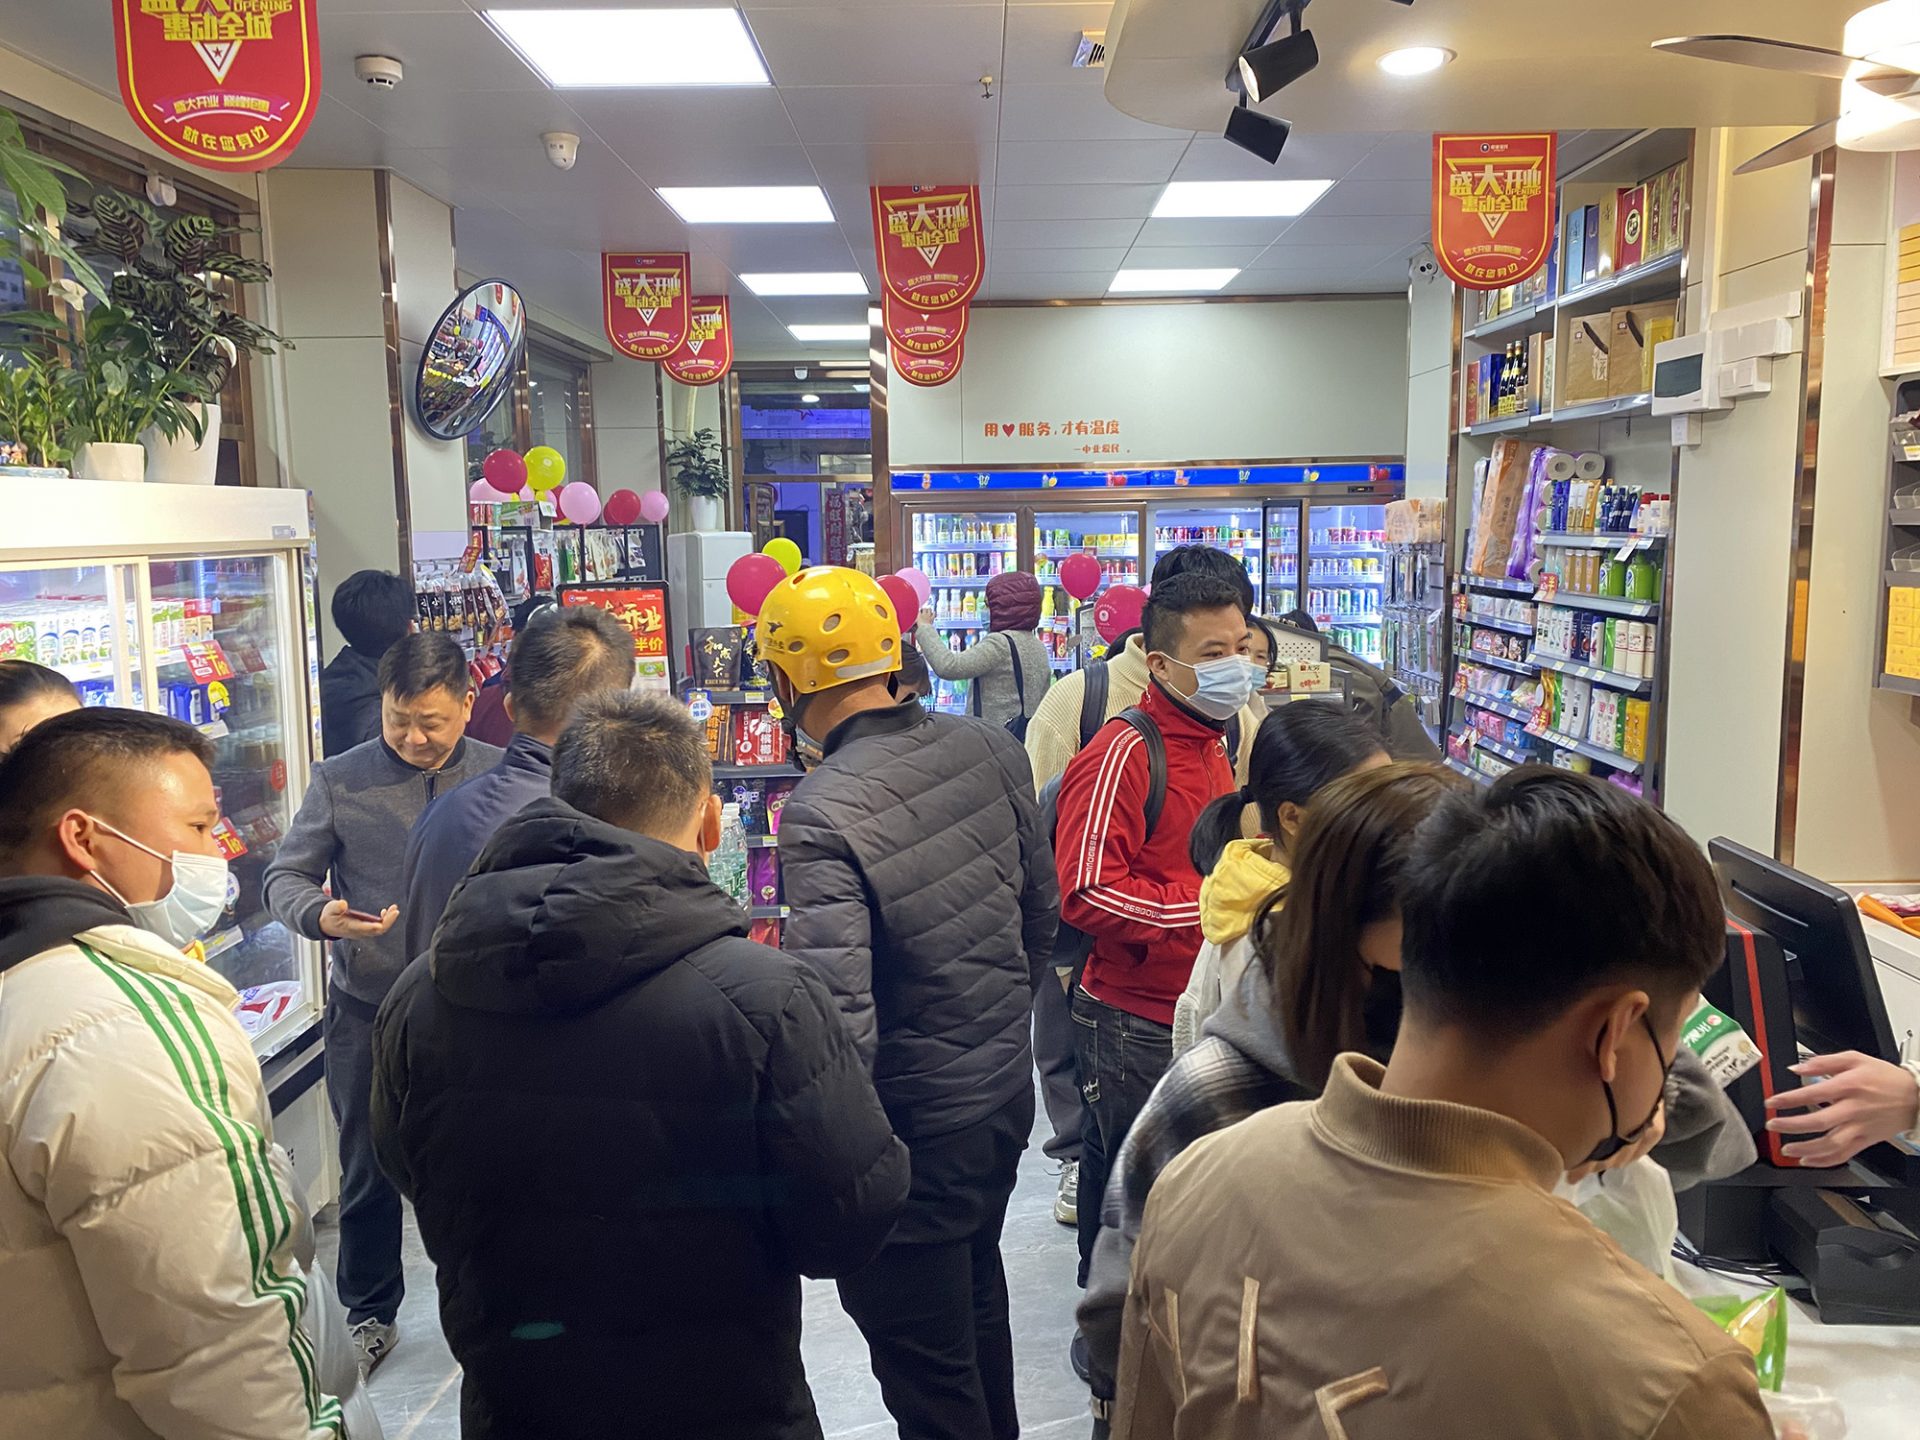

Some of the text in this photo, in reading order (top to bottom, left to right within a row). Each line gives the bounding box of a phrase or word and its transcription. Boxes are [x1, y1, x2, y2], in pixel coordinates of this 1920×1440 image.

[182, 125, 270, 152] 就在您身边
[1449, 163, 1541, 196] 盛大开业
[888, 203, 968, 233] 盛大开业
[614, 273, 681, 296] 盛大开业
[634, 636, 663, 652] 半价
